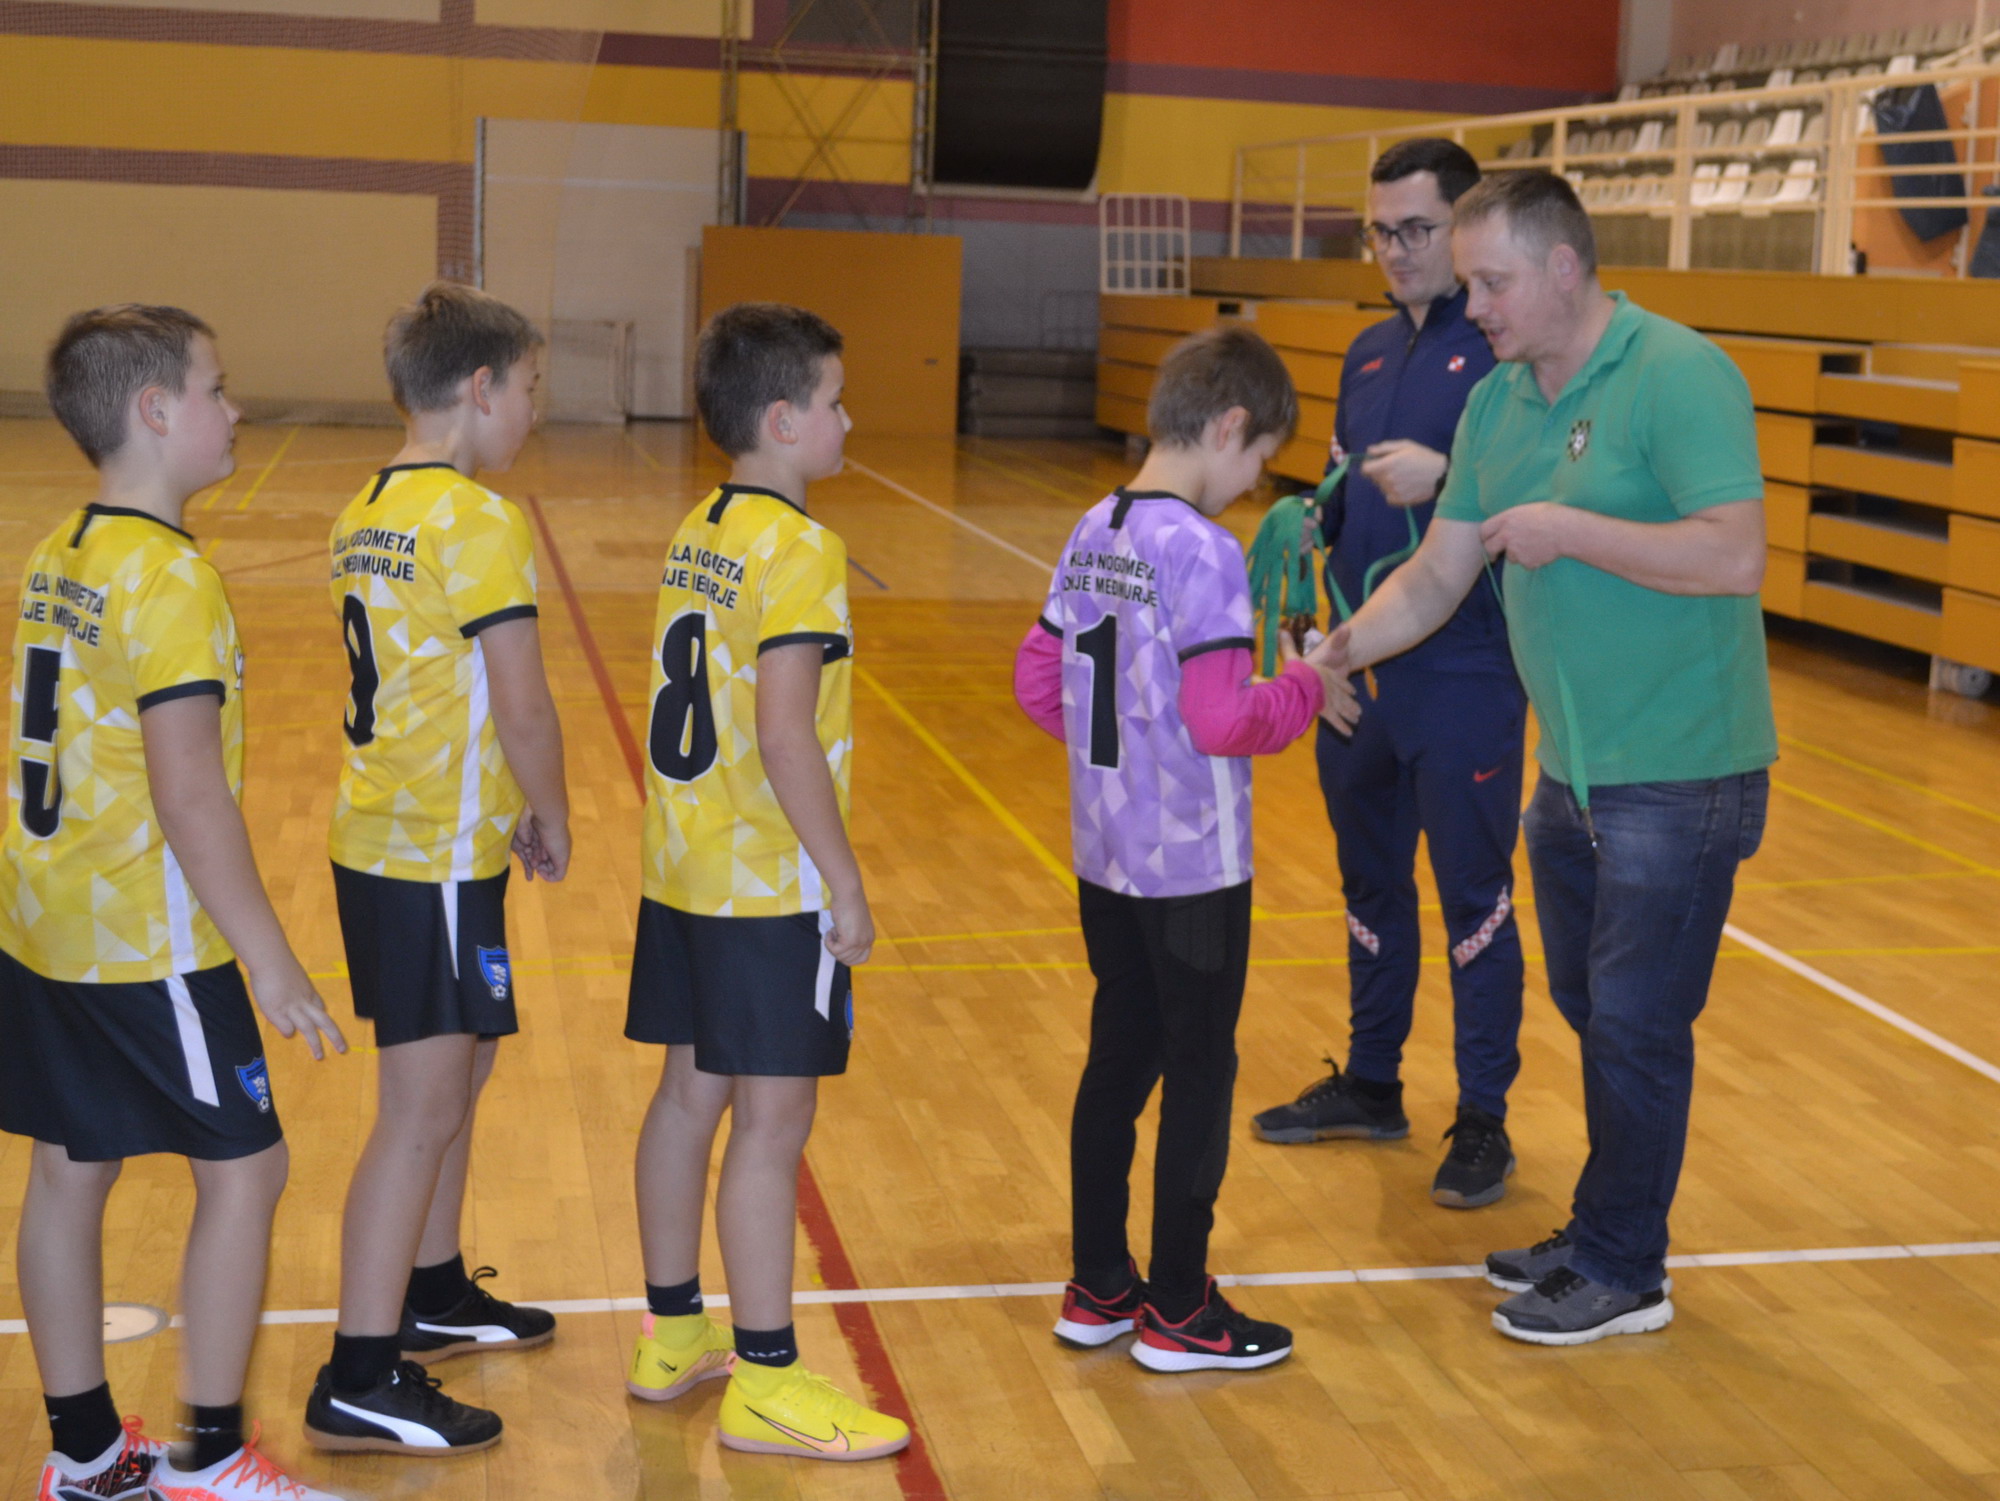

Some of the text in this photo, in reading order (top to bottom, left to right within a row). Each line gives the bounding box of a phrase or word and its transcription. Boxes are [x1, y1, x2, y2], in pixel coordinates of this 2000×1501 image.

[342, 593, 379, 747] 9
[648, 610, 719, 783] 8
[1075, 611, 1121, 770] 1
